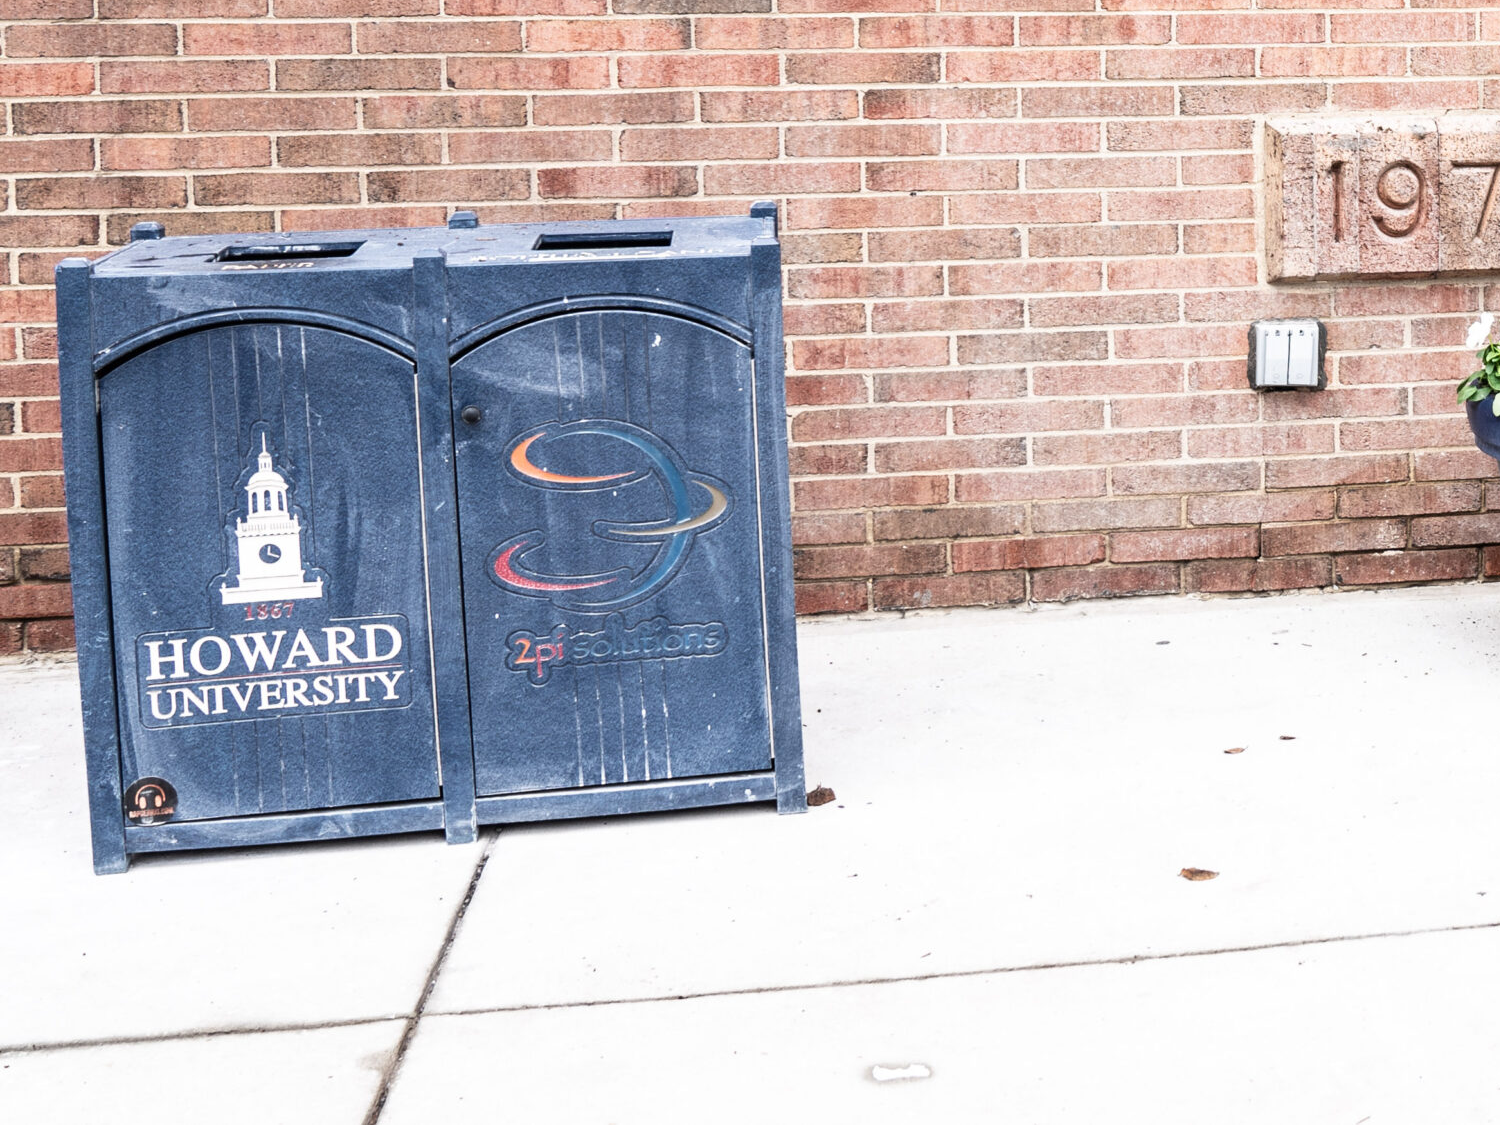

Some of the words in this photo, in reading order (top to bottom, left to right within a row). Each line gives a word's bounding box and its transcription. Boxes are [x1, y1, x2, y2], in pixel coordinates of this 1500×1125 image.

[244, 601, 295, 621] 1867
[144, 622, 403, 681] HOWARD
[514, 631, 564, 678] 2pi
[145, 669, 405, 720] UNIVERSITY
